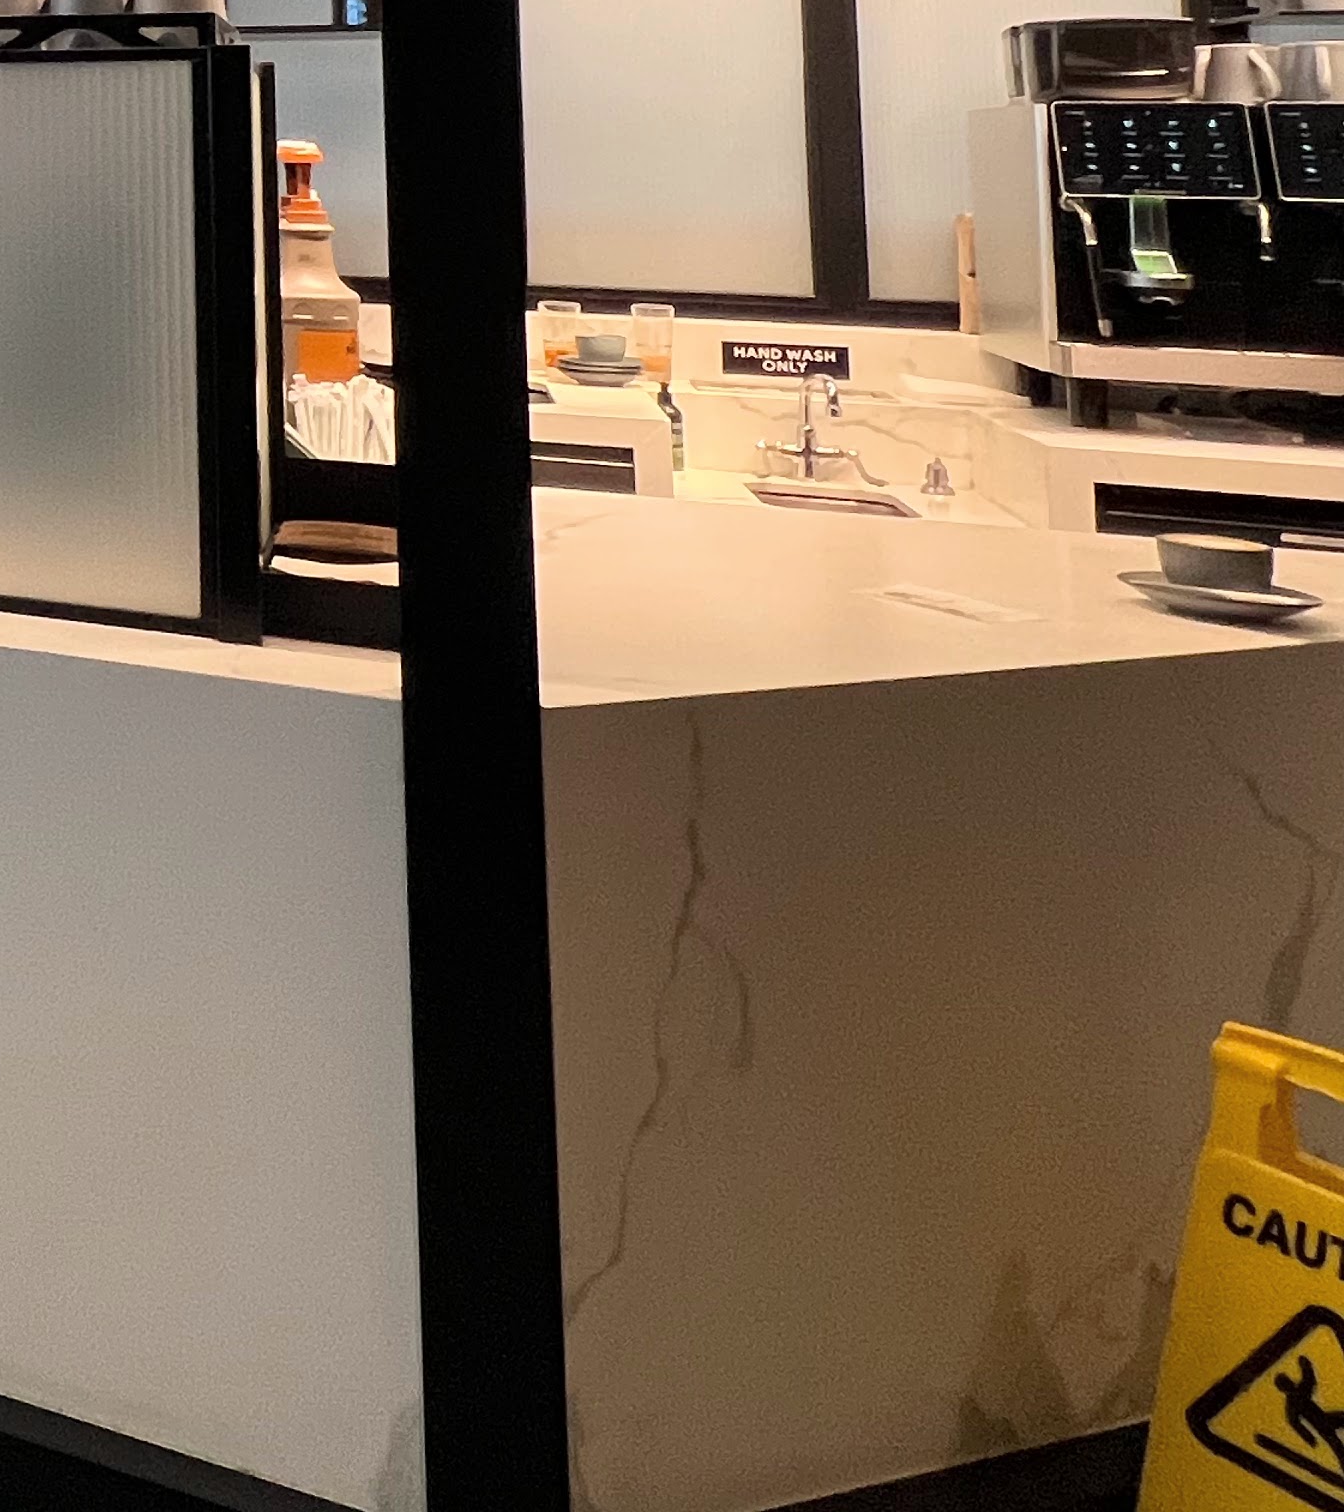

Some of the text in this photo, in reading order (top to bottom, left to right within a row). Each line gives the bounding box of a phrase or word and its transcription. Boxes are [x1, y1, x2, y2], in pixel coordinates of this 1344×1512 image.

[733, 346, 837, 363] HAND WASH
[762, 360, 808, 374] ONLY
